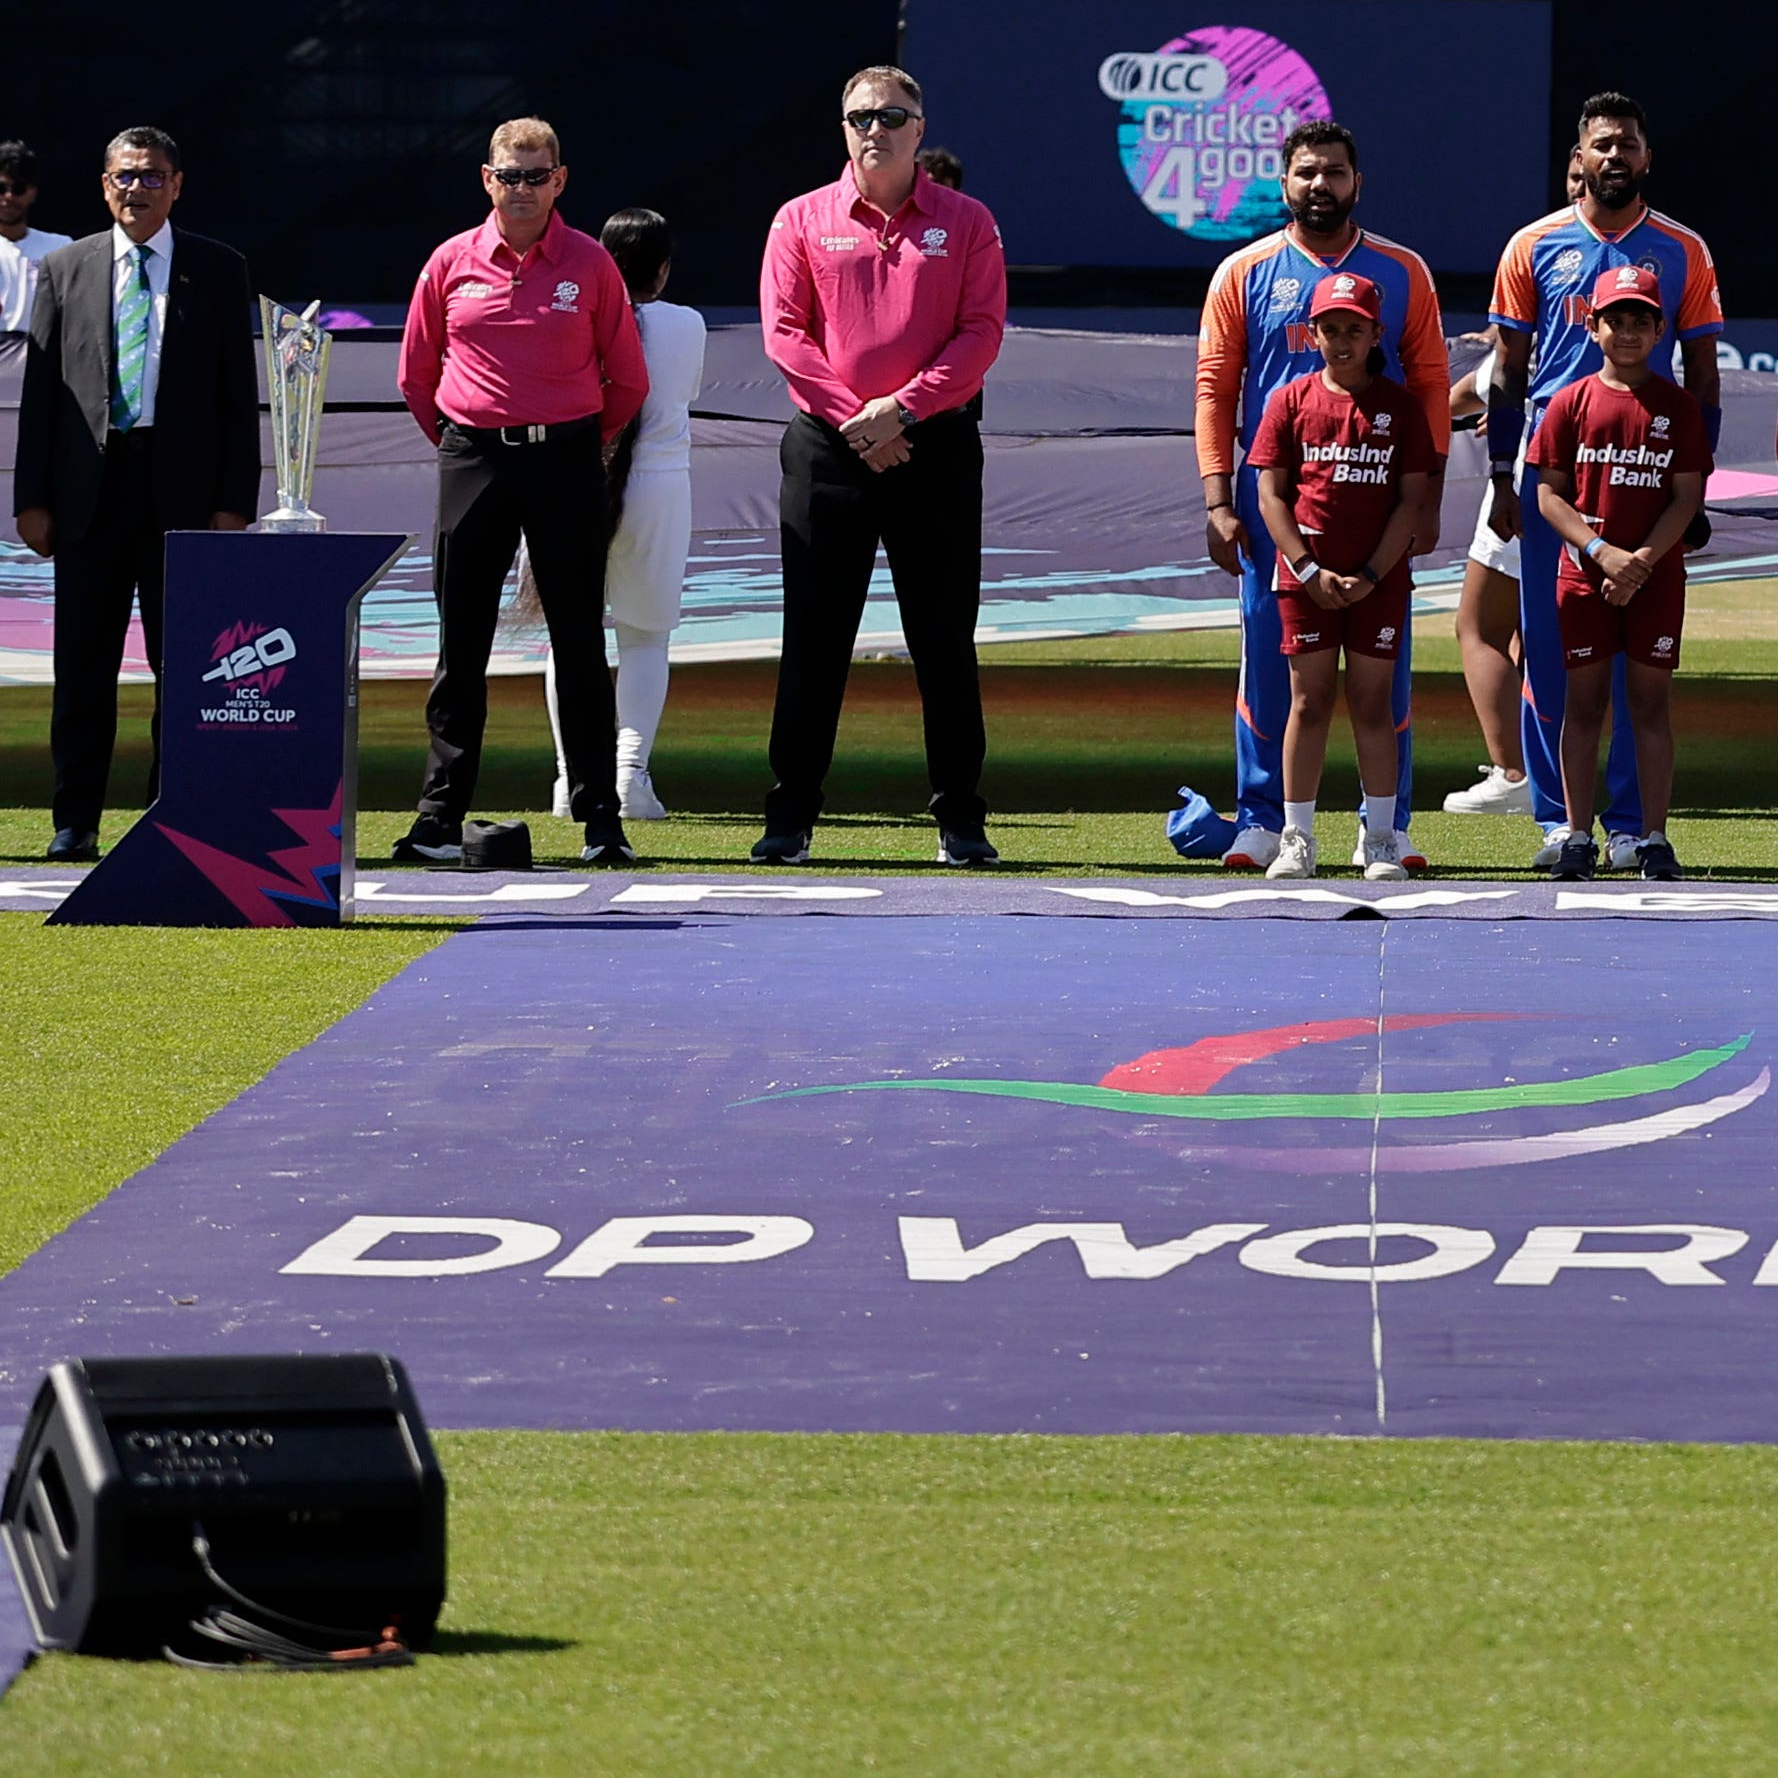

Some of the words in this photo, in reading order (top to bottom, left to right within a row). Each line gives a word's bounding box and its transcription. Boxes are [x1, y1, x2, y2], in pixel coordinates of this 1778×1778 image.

[1148, 62, 1208, 93] ICC
[1144, 102, 1300, 144] Cricket
[1142, 145, 1208, 230] 4
[1200, 146, 1286, 189] goo
[1302, 441, 1395, 464] IndusInd
[1576, 443, 1674, 468] IndusInd
[1332, 464, 1389, 485] Bank
[1609, 466, 1663, 488] Bank
[236, 688, 260, 699] ICC
[200, 708, 260, 722] WORLD
[263, 709, 296, 723] CUP
[278, 1215, 815, 1279] DP
